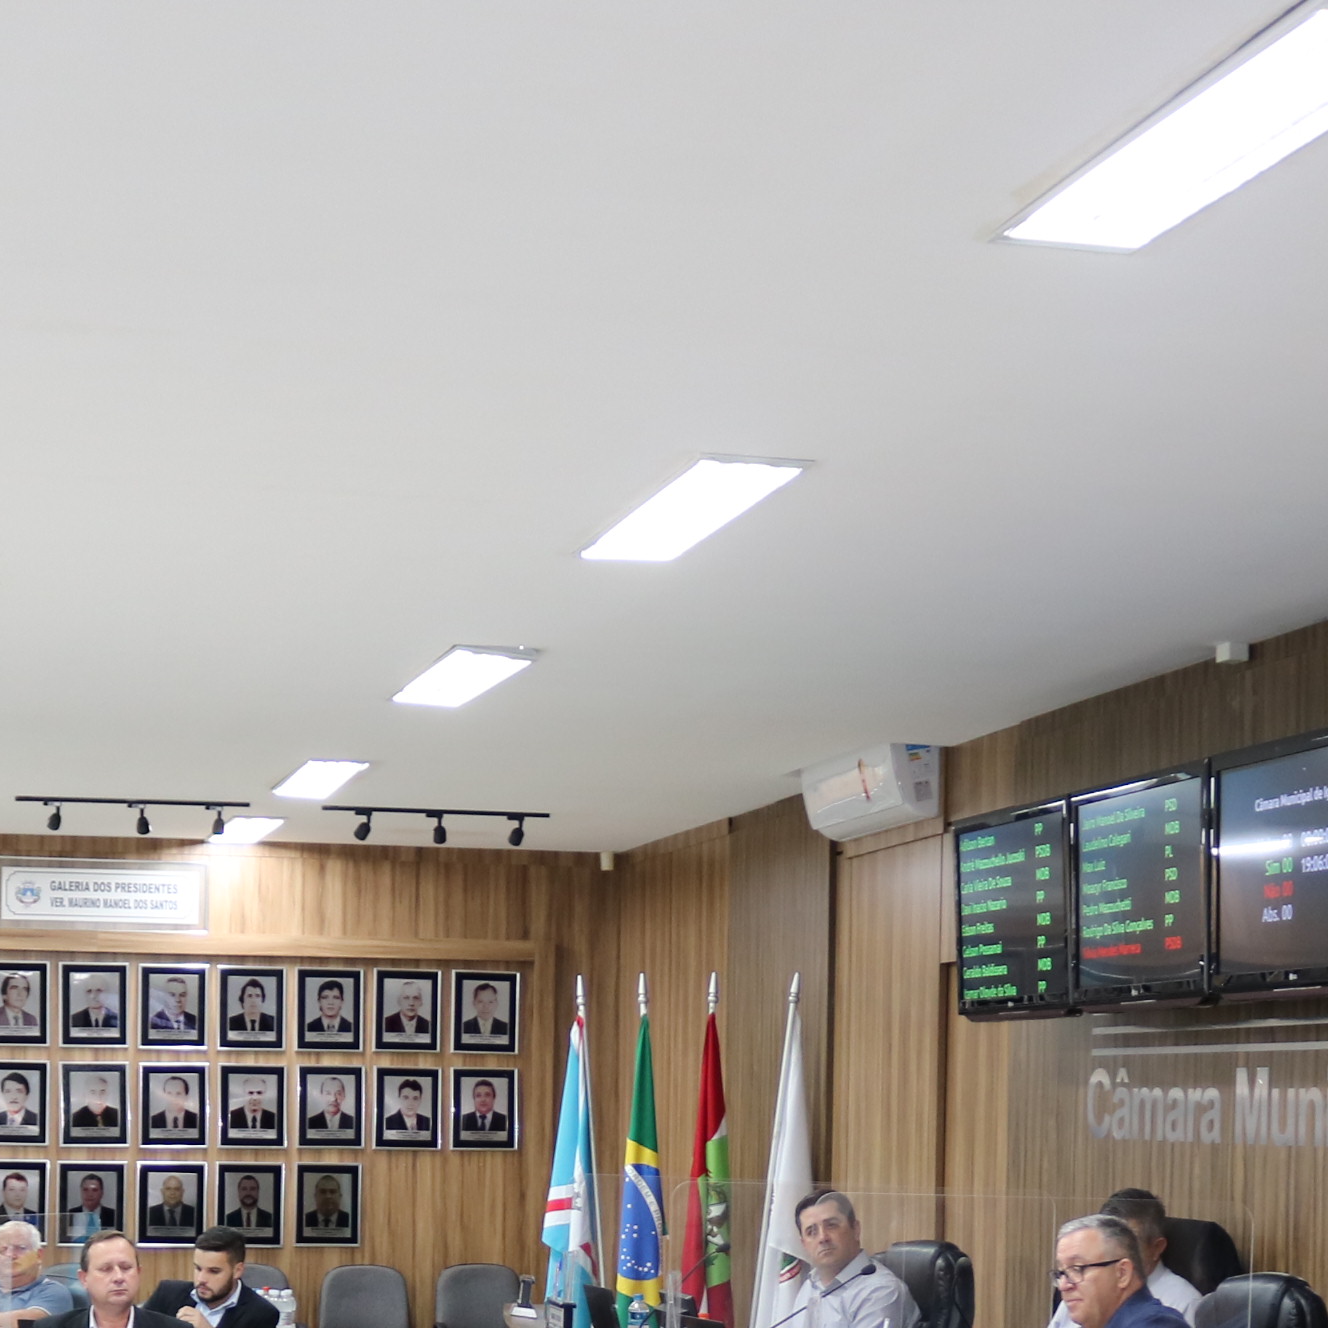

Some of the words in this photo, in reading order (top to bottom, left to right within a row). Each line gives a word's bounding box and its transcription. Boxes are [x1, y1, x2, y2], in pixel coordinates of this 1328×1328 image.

[1165, 798, 1177, 812] PSD
[1254, 798, 1279, 812] Câmara
[1280, 787, 1313, 806] Municipal
[1314, 786, 1323, 801] de
[1034, 822, 1043, 835] PP
[1165, 821, 1180, 835] MDB
[1035, 844, 1051, 858] PSDB
[1165, 845, 1174, 858] PL
[1264, 859, 1281, 876] Sim
[1282, 857, 1293, 873] 00
[1036, 867, 1050, 881] MDB
[1165, 868, 1178, 881] PSD
[50, 880, 90, 893] GALERIA
[92, 881, 112, 893] DOS
[114, 882, 179, 895] PRESIDENTES
[1282, 880, 1294, 897] 00
[50, 897, 66, 908] VER.
[67, 897, 102, 910] MAURINO
[103, 898, 132, 910] MANOEL
[133, 898, 148, 910] DOS
[149, 899, 179, 911] SANTOS
[1036, 890, 1045, 904] PP
[1165, 890, 1180, 904] MDB
[1037, 912, 1051, 926] MDB
[1262, 907, 1280, 922] Abs.
[1282, 904, 1293, 920] 00
[1165, 914, 1174, 928] PP
[1037, 935, 1047, 949] PP
[1037, 957, 1052, 972] MDB
[1038, 981, 1047, 994] PP
[1086, 1066, 1221, 1144] Câmara
